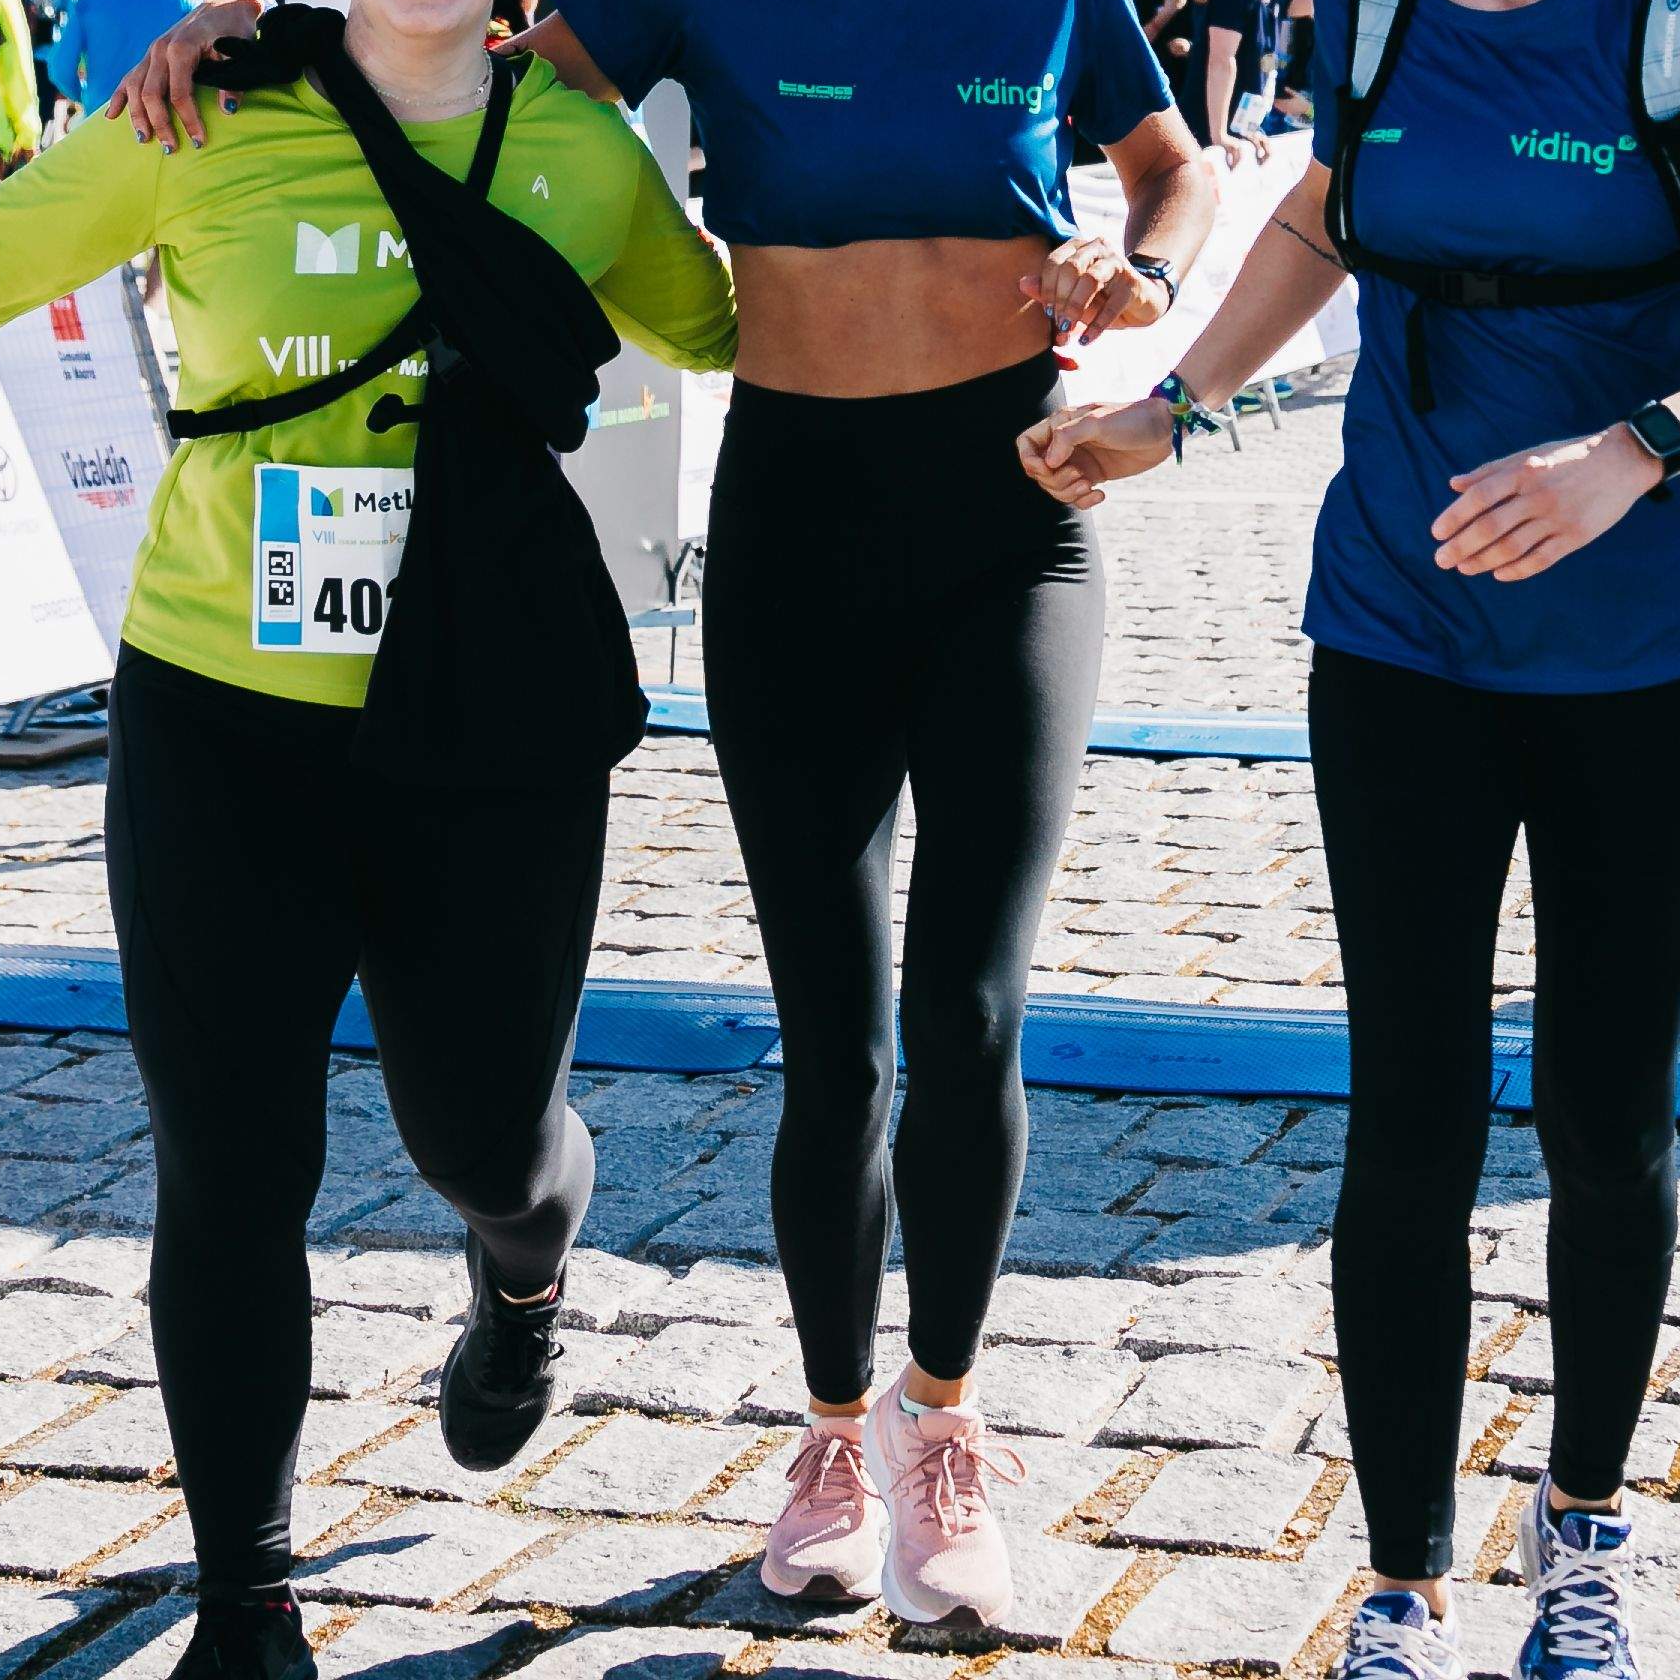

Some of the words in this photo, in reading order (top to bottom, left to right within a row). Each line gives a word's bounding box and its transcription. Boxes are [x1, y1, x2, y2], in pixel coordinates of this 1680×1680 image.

[957, 77, 1043, 115] viding
[1510, 128, 1616, 175] viding
[258, 335, 331, 378] VIII
[60, 444, 133, 489] Vitaldin
